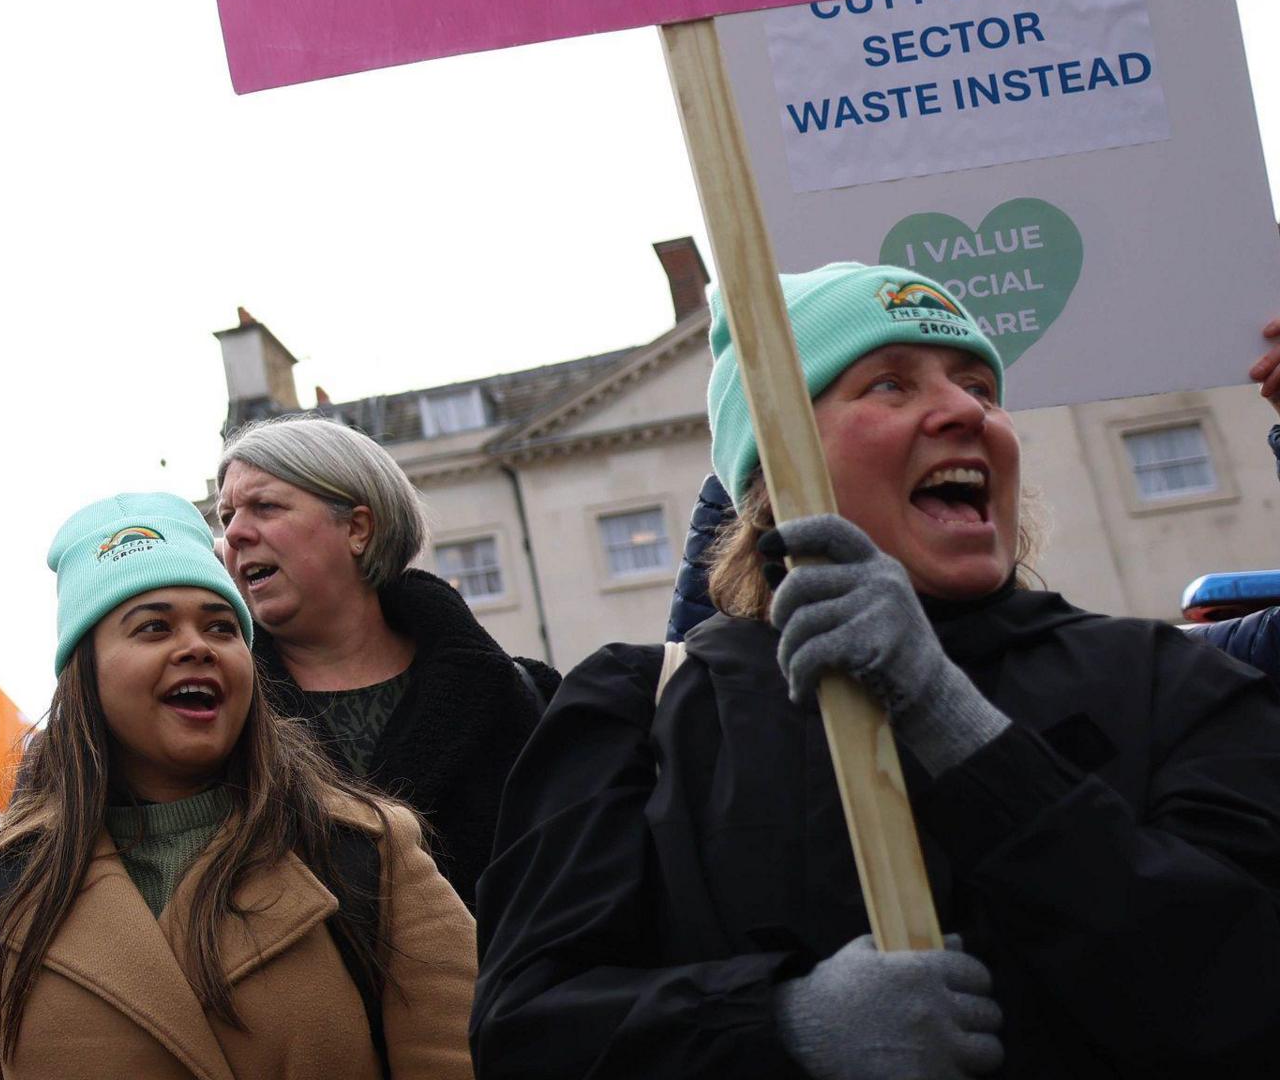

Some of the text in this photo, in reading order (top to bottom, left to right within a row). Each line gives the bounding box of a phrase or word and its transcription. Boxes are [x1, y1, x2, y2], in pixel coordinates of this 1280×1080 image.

[863, 12, 1045, 67] SECTOR
[787, 52, 1152, 134] WASTE INSTEAD
[905, 225, 1044, 266] I VALUE
[942, 269, 1044, 301] OCIAL
[919, 322, 969, 336] GROUP
[978, 309, 1040, 337] ARE
[112, 545, 153, 562] GROUP
